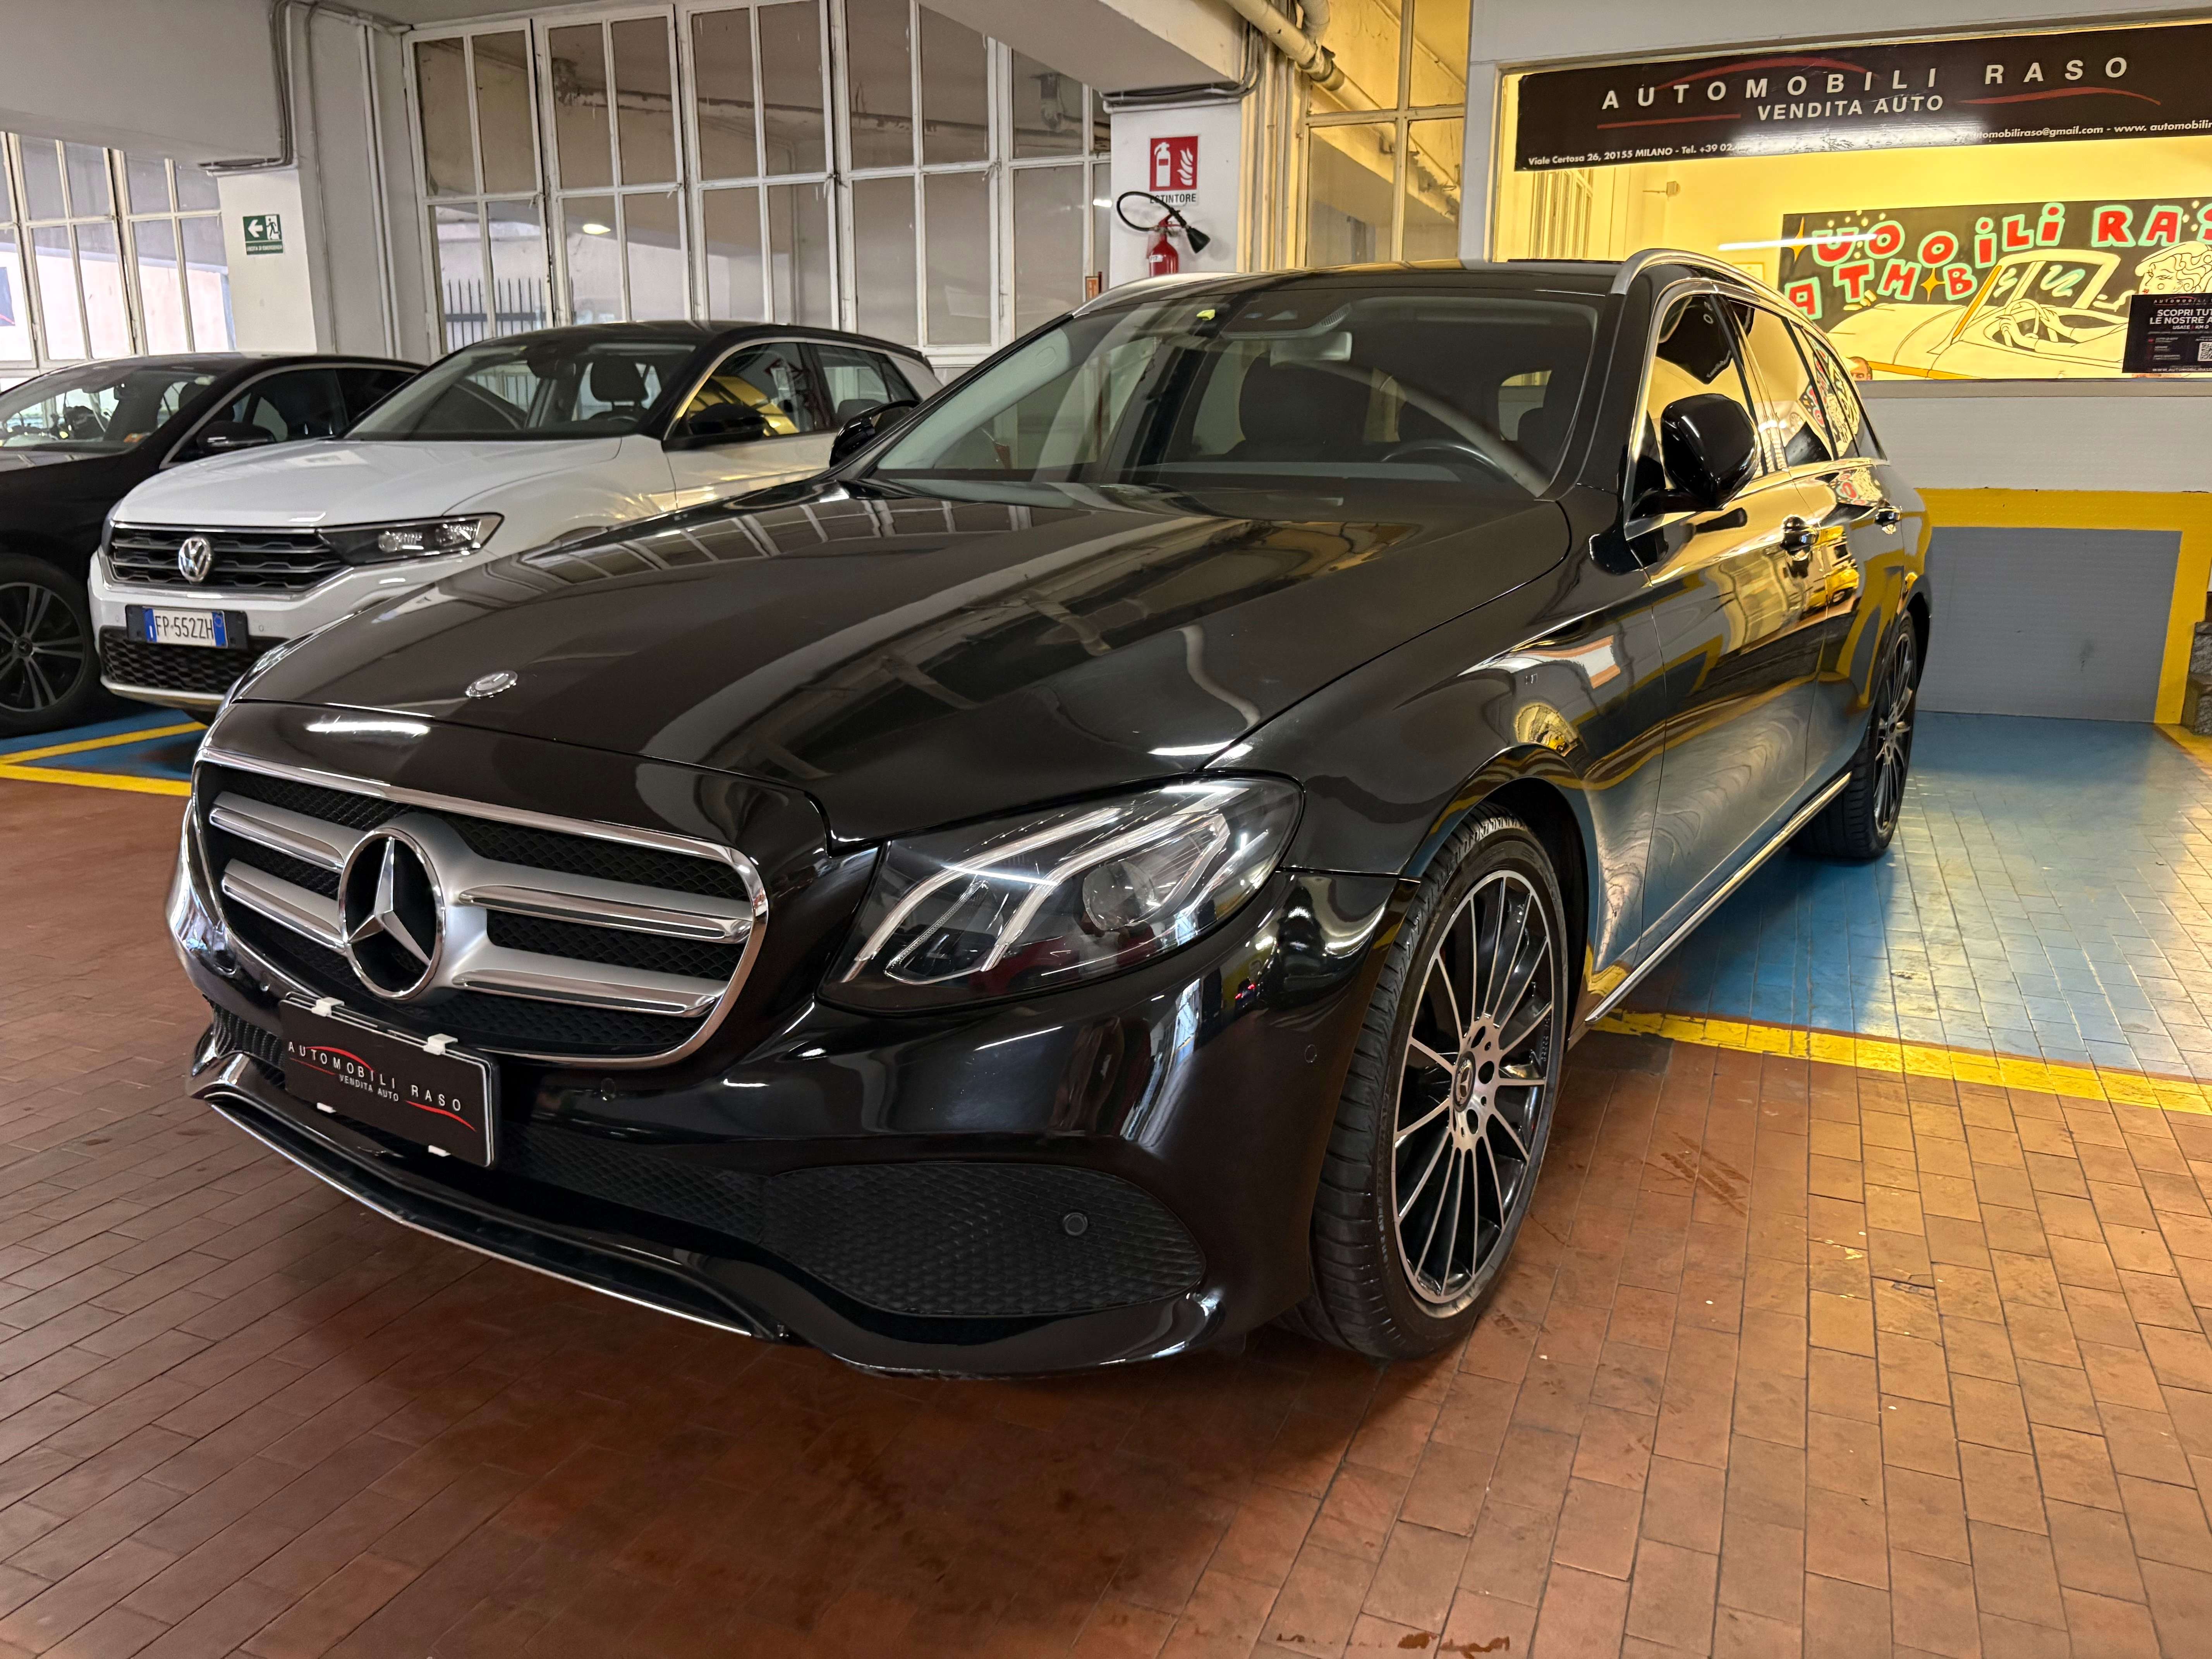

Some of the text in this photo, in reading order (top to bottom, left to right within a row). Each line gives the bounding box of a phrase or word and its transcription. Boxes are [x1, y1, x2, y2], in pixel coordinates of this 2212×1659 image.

[1601, 57, 2127, 110] AUTOMOBILI RASO
[1757, 95, 1943, 120] VENDITA AUTO
[1528, 156, 1550, 165] Viale
[1552, 154, 1585, 164] Certosa
[1587, 153, 1602, 161] 26,
[1604, 149, 1633, 160] 20155
[1635, 147, 1673, 157] MILANO
[1681, 145, 1697, 154] Tel.
[1699, 144, 1718, 153] +39
[1973, 125, 2103, 139] tomobiliraso@gmail.com
[288, 1041, 461, 1111] AUTOMOBILI RASO
[338, 1074, 398, 1102] VENDITA AUTO
